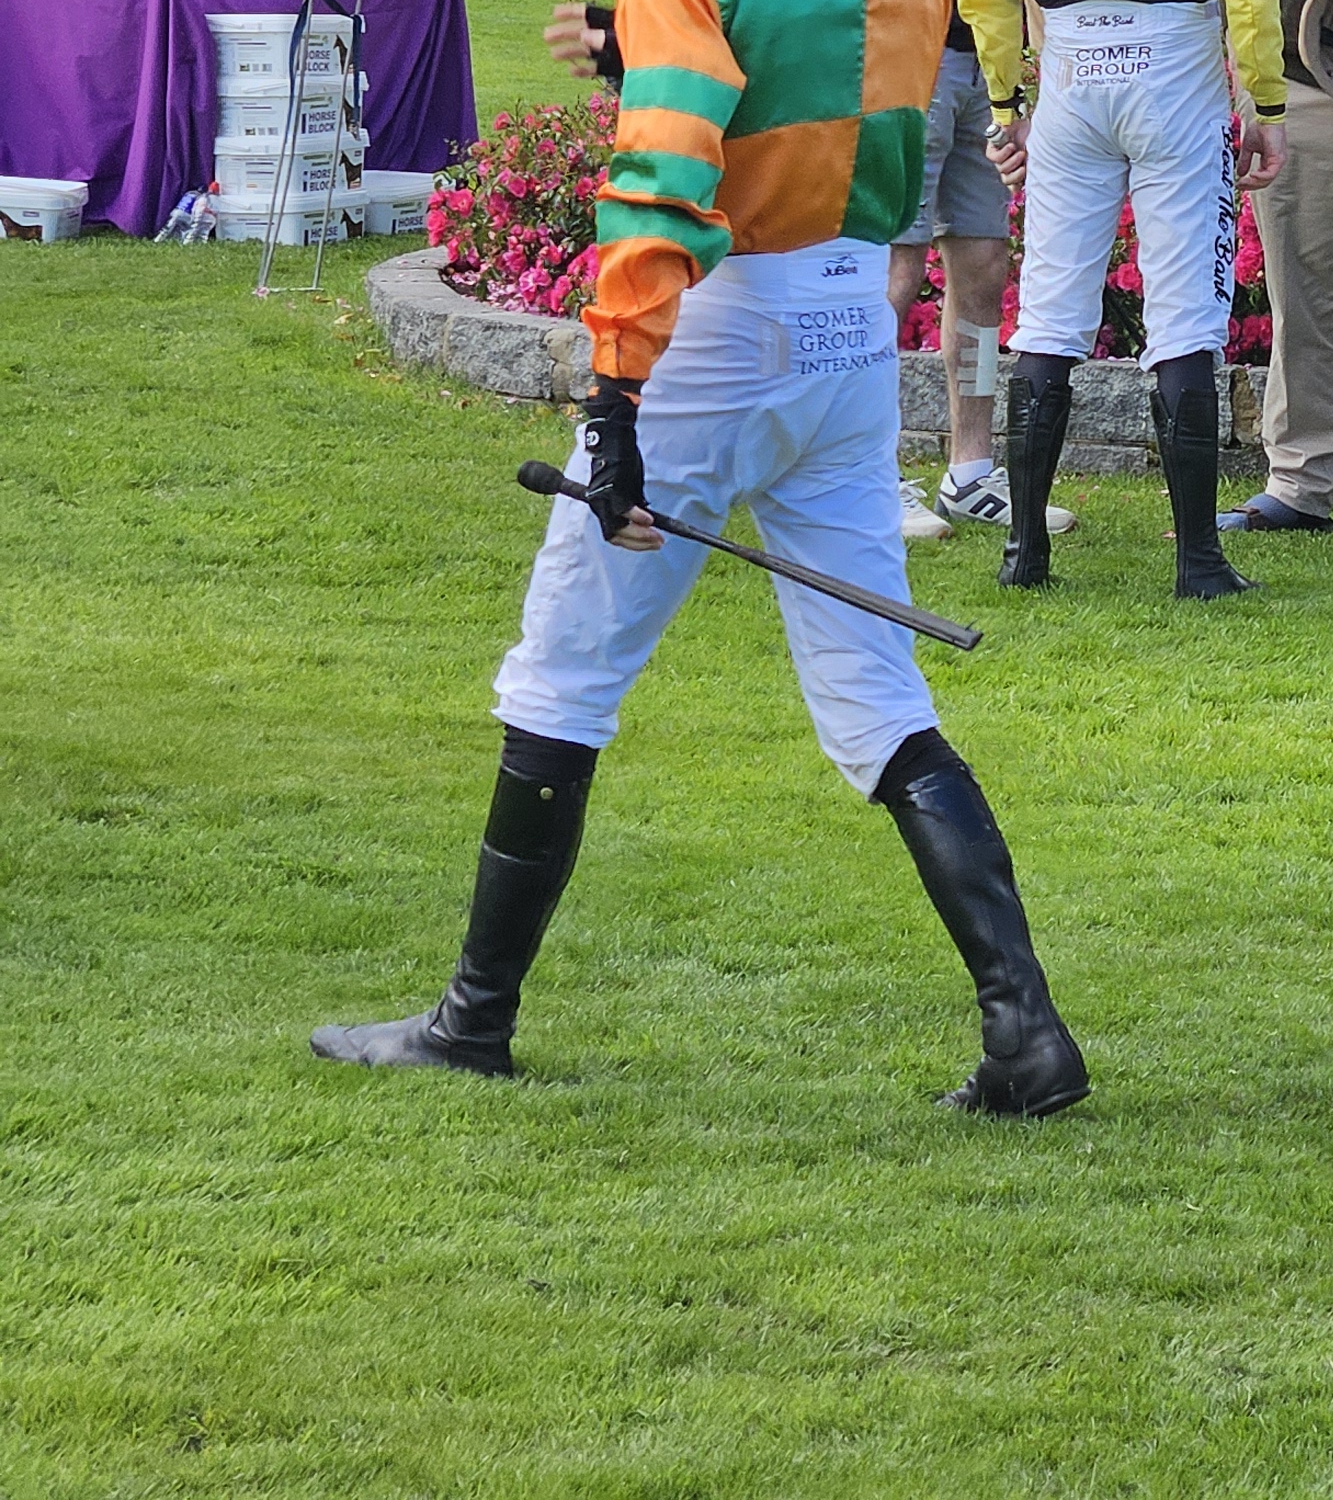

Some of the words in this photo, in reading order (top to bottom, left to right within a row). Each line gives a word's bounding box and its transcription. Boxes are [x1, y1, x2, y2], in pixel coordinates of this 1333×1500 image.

[1076, 46, 1152, 62] COMER
[1076, 62, 1149, 77] GROUP
[309, 110, 337, 121] HORSE
[308, 121, 336, 132] BLOCK
[1217, 190, 1235, 235] The
[1213, 235, 1234, 304] Bank
[797, 307, 870, 330] COMER
[800, 330, 868, 352] GROUP
